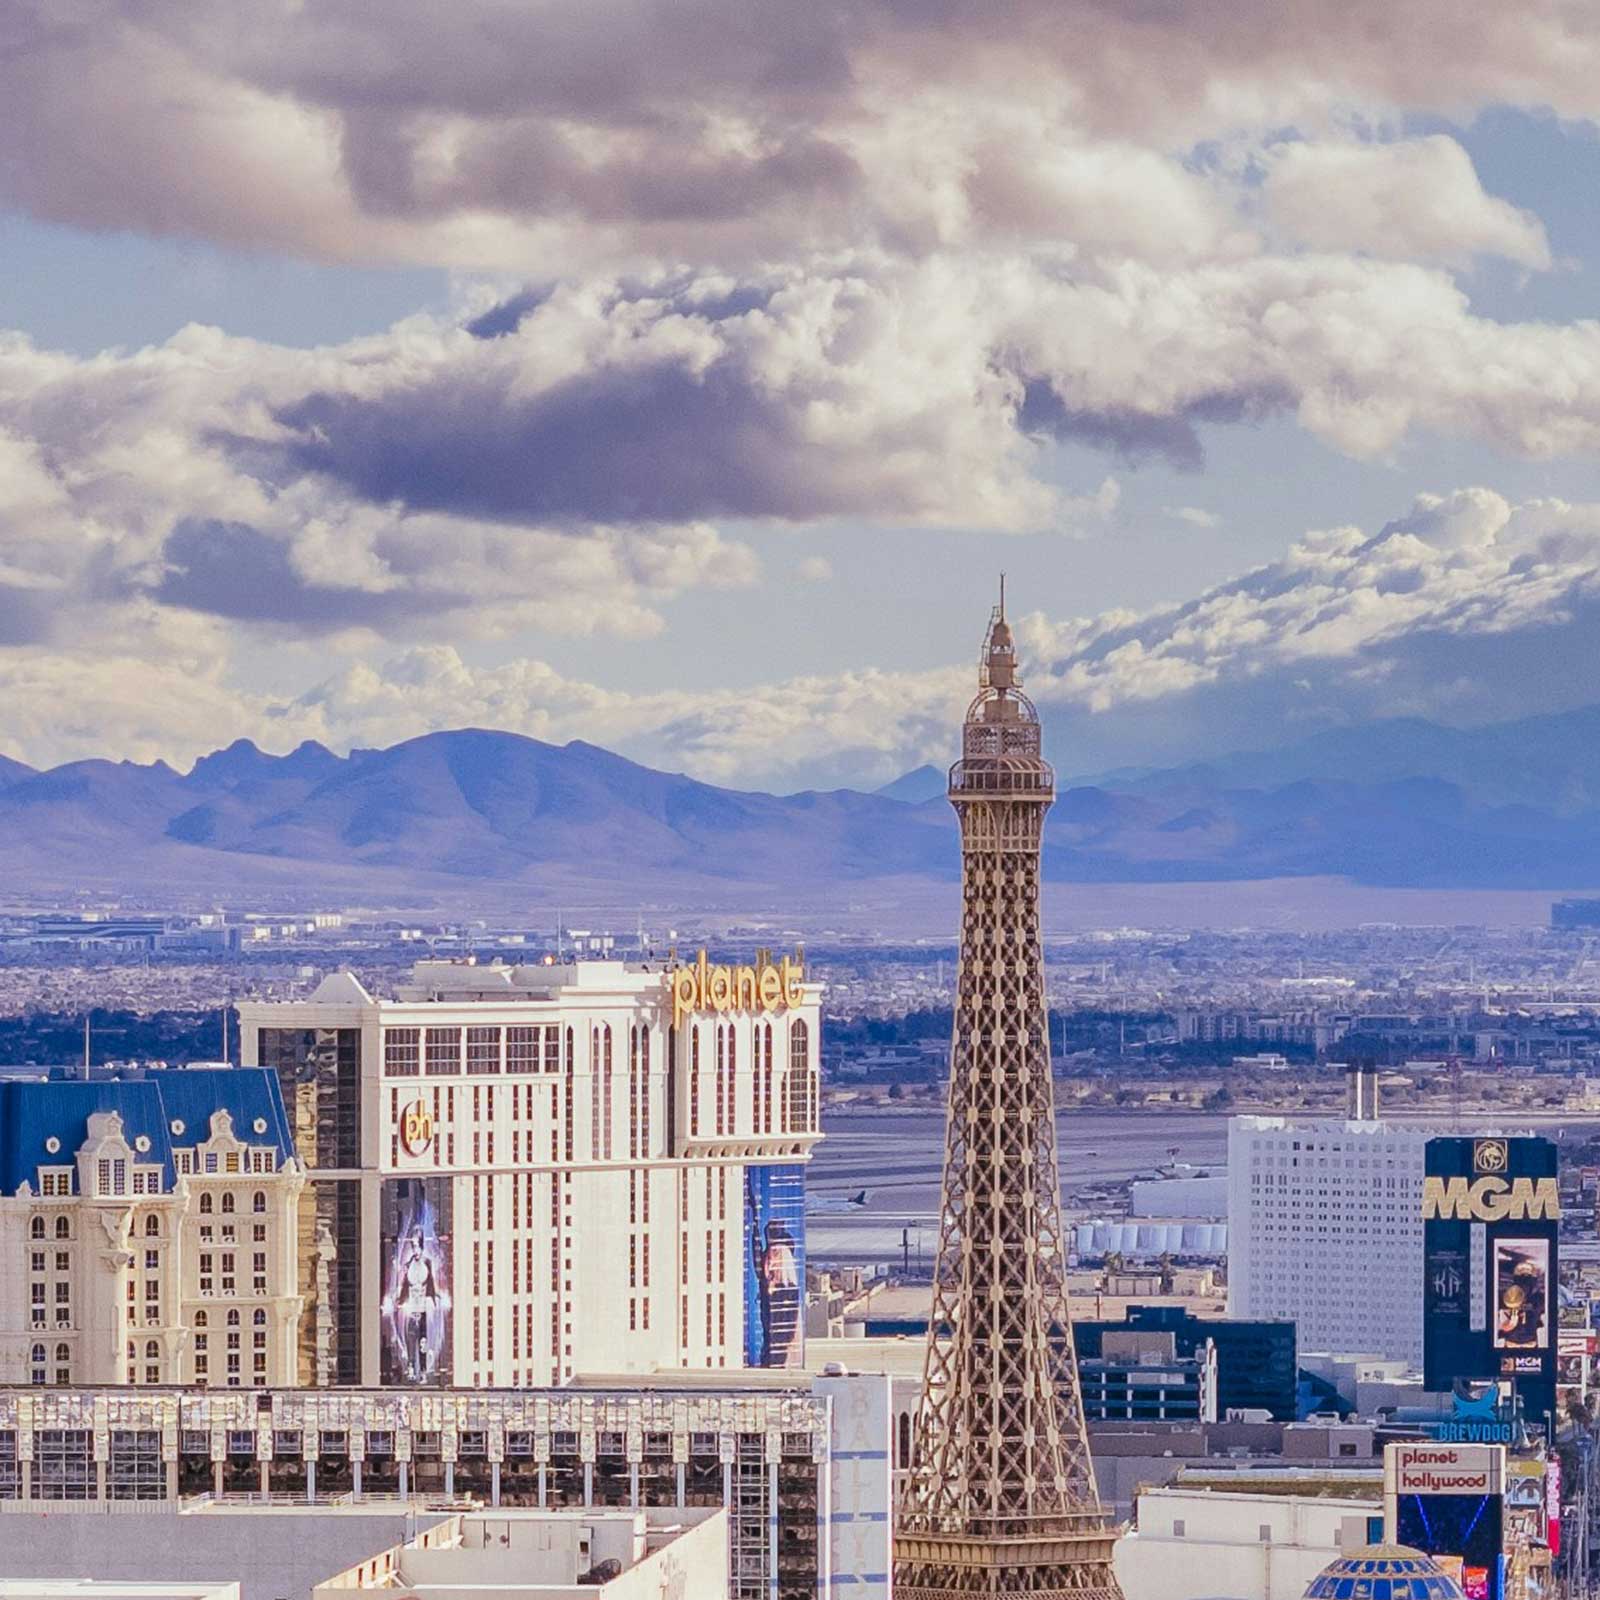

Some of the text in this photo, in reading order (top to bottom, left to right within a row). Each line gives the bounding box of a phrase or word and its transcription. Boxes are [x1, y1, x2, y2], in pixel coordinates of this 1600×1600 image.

[671, 948, 806, 1031] planet
[1421, 1176, 1561, 1221] MGM
[1439, 1423, 1511, 1442] BREWDOG
[1402, 1450, 1458, 1468] planet
[1402, 1473, 1487, 1491] hollywood
